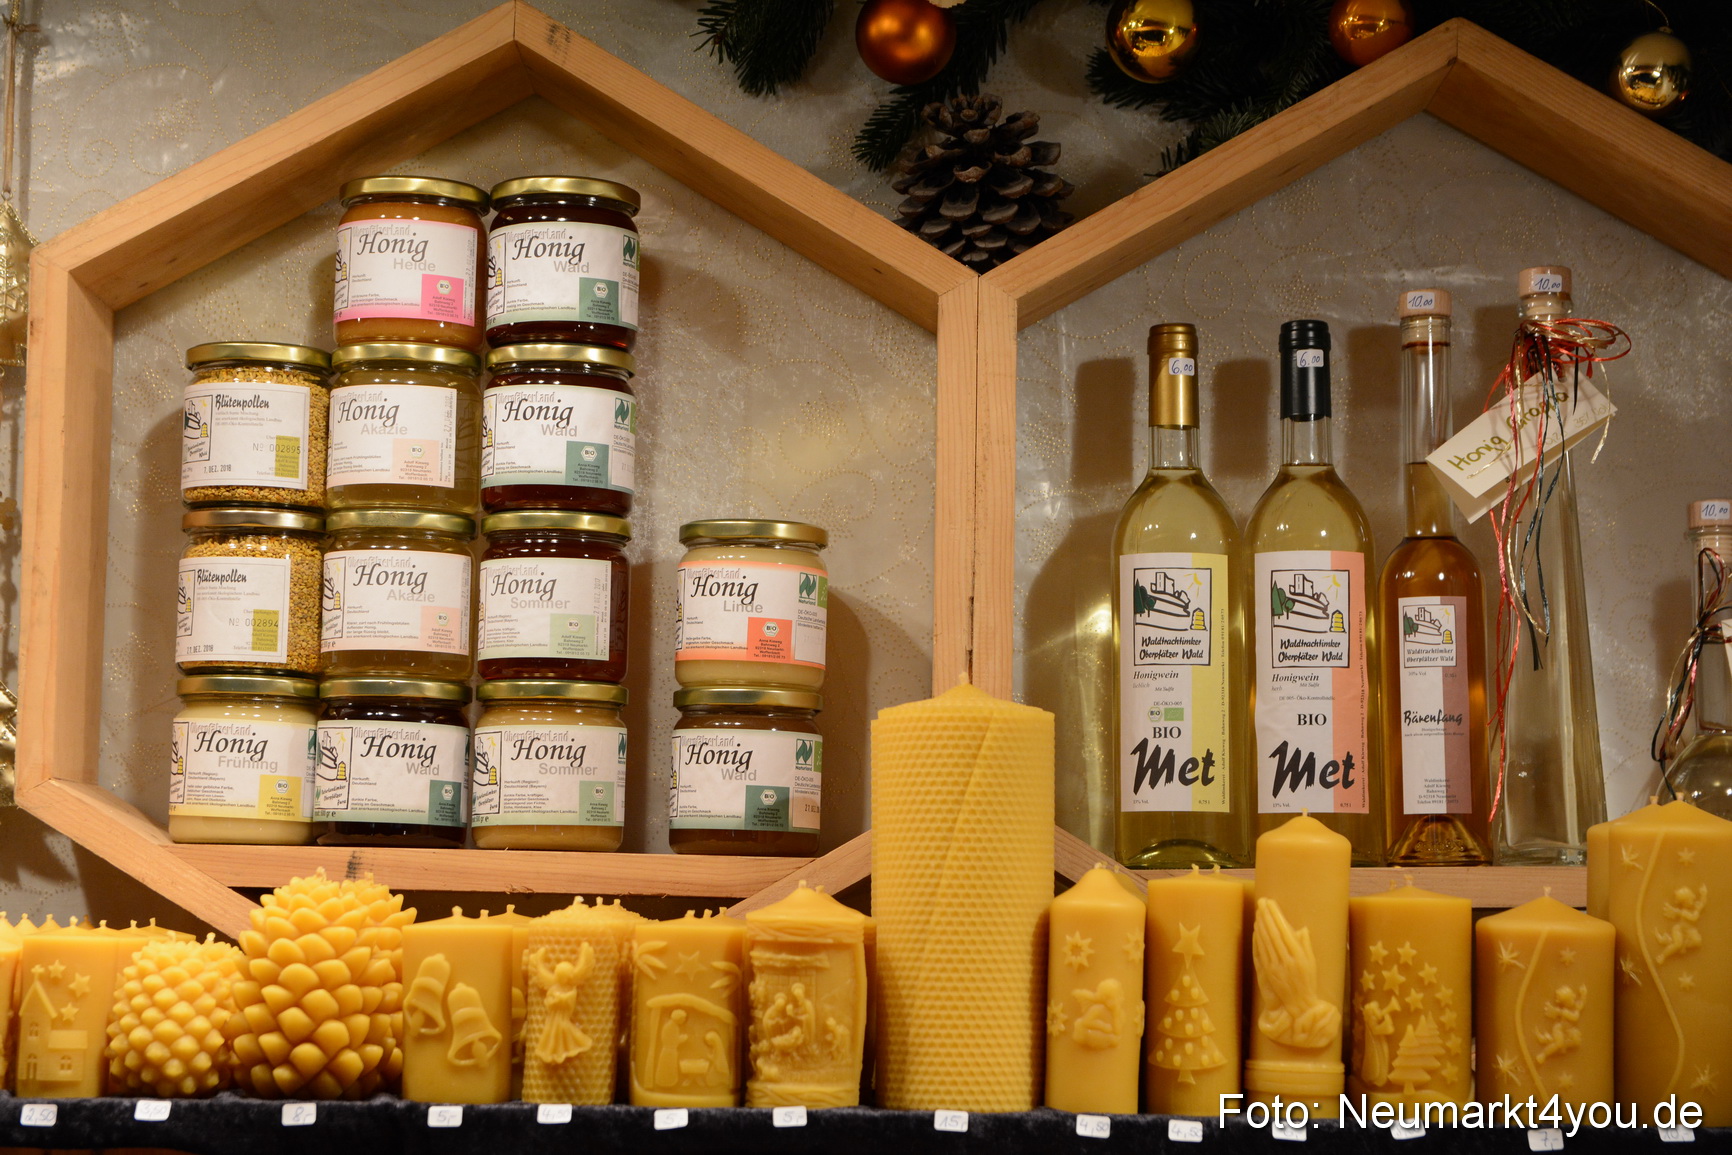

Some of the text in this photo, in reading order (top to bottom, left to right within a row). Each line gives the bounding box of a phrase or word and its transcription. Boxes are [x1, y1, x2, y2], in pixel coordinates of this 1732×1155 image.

[357, 232, 429, 262] Honig
[512, 236, 585, 265] Honig
[393, 258, 436, 272] Heide
[554, 261, 589, 273] Wald
[215, 394, 270, 410] Blütenpollen
[338, 399, 400, 427] Honig
[502, 399, 574, 429] Honig
[361, 423, 408, 435] Akazie
[541, 424, 578, 437] Wald
[269, 444, 301, 455] 002895
[1447, 434, 1511, 471] Honig
[220, 464, 232, 472] 2018
[197, 568, 247, 585] Blütenpollen
[353, 563, 428, 594] Honig
[490, 572, 557, 601] Honig
[691, 575, 759, 605] Honig
[387, 589, 435, 602] Akazie
[510, 597, 571, 609] Sommer
[723, 600, 763, 614] Linde
[245, 619, 279, 628] 002894
[1141, 636, 1202, 647] Waldtrachtimker
[1280, 638, 1341, 649] Waldtrachtimker
[1140, 648, 1204, 660] Oberpfälzer Wald
[1278, 651, 1343, 663] Oberpfälzer Wald
[1133, 670, 1179, 680] Honigwein
[1272, 673, 1319, 683] Honigwein
[1297, 713, 1327, 726] BIO
[1403, 709, 1463, 726] Bärenfang
[1152, 726, 1182, 739] BIO
[194, 730, 268, 762] Honig
[360, 734, 437, 767] Honig
[511, 737, 587, 768] Honig
[218, 755, 279, 773] Frühling
[685, 742, 754, 773] Honig
[406, 762, 440, 776] Wald
[539, 762, 598, 776] Sommer
[1130, 737, 1216, 796] Met
[1268, 740, 1355, 799] Met
[721, 768, 757, 781] Wald
